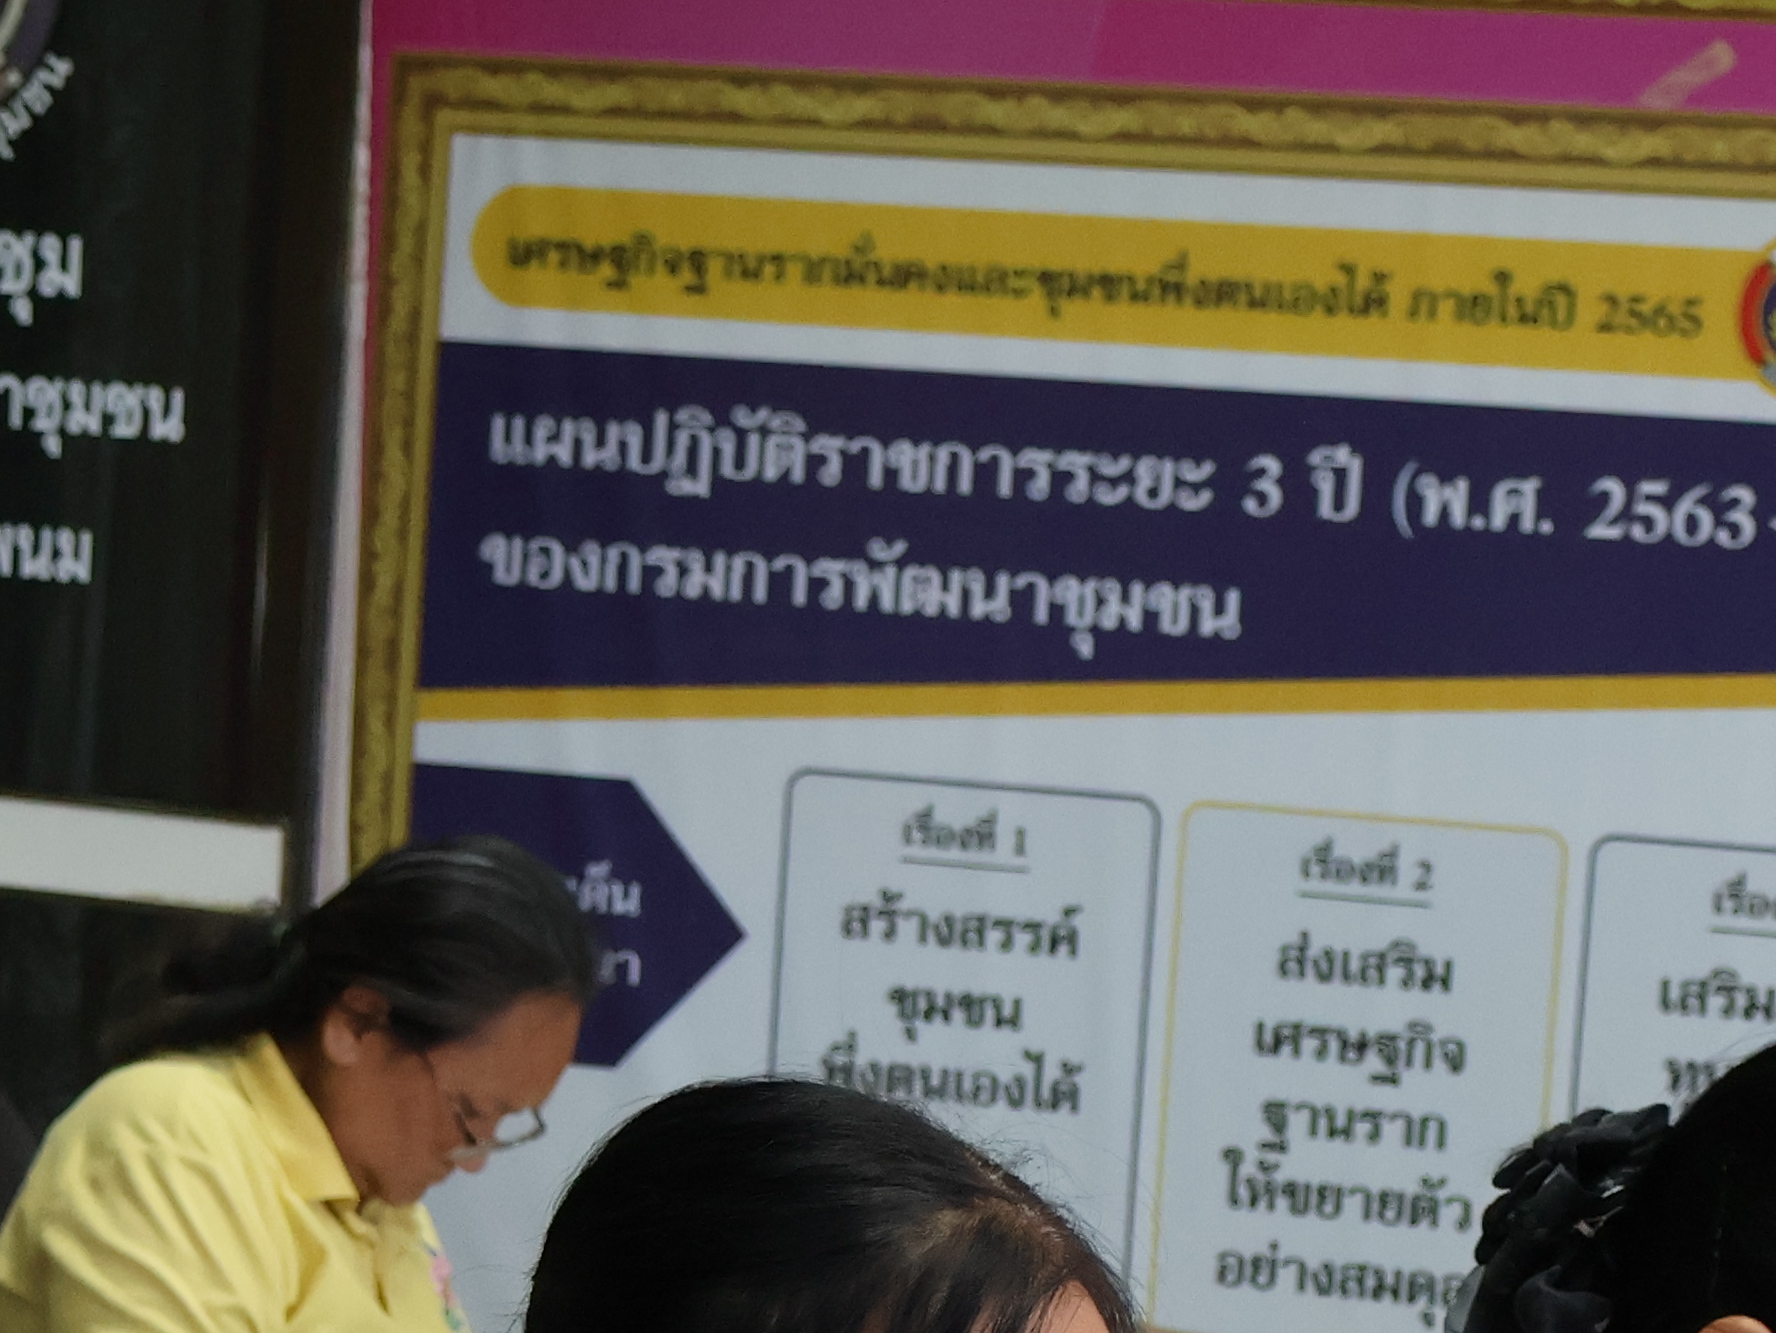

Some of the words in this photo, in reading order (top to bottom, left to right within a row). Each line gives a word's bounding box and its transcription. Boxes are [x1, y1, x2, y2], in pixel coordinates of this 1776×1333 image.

[1406, 265, 1576, 330] ภายในปี
[1595, 294, 1704, 339] 2565
[488, 404, 1214, 515] แผนปฏิบัติราชการระยะ
[1242, 455, 1283, 519] 3
[1308, 441, 1365, 522] ปี
[1392, 460, 1554, 538] (พ.ศ.
[479, 528, 1241, 660] ของกรมการพัฒนาชุมชน
[901, 804, 999, 857] เรื่องที่
[1013, 826, 1030, 858] 1
[1299, 837, 1400, 890] เรื่องที่
[1412, 859, 1433, 892] 2
[841, 898, 1081, 960] สร้างสรรค์
[1276, 933, 1453, 996] ส่งเสริม
[888, 982, 1022, 1051] ชุมชน
[1253, 1014, 1467, 1089] เศรษฐกิจ
[1262, 1090, 1447, 1156] ฐานราก
[1219, 1148, 1472, 1234] ให้ขยายตัว
